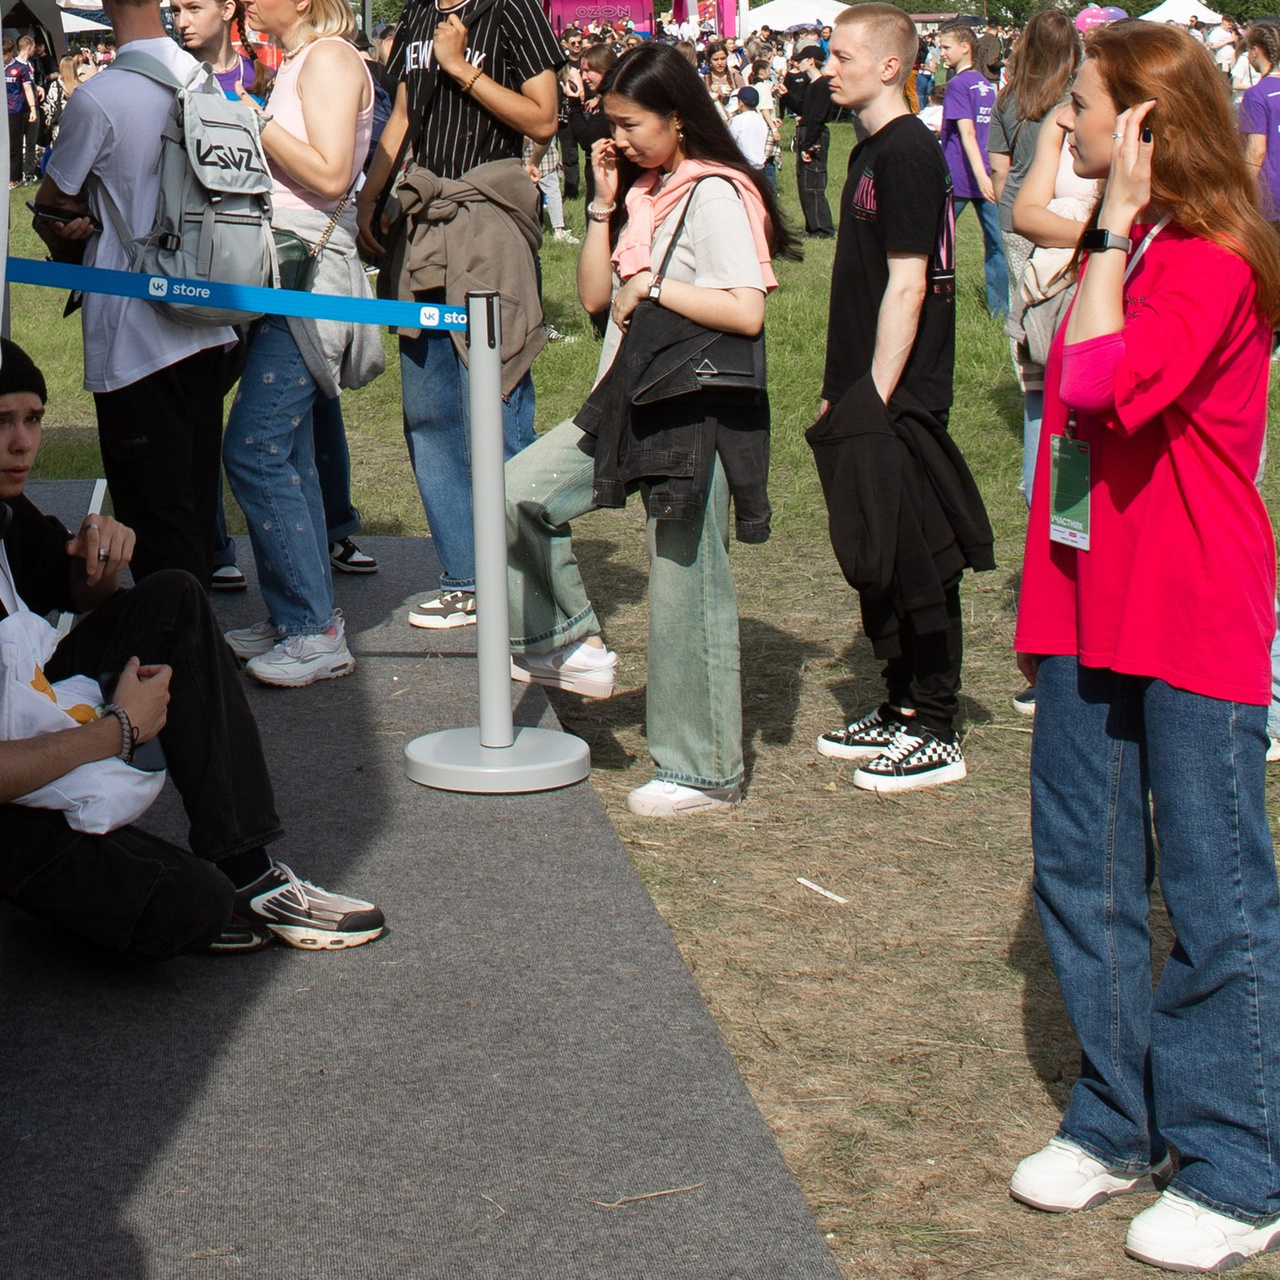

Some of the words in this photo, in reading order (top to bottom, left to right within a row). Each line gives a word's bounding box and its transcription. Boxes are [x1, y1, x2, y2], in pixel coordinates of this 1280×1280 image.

[575, 5, 631, 18] OZON
[173, 283, 211, 298] store
[444, 311, 468, 324] sto
[1051, 514, 1084, 531] УЧАСТНИК
